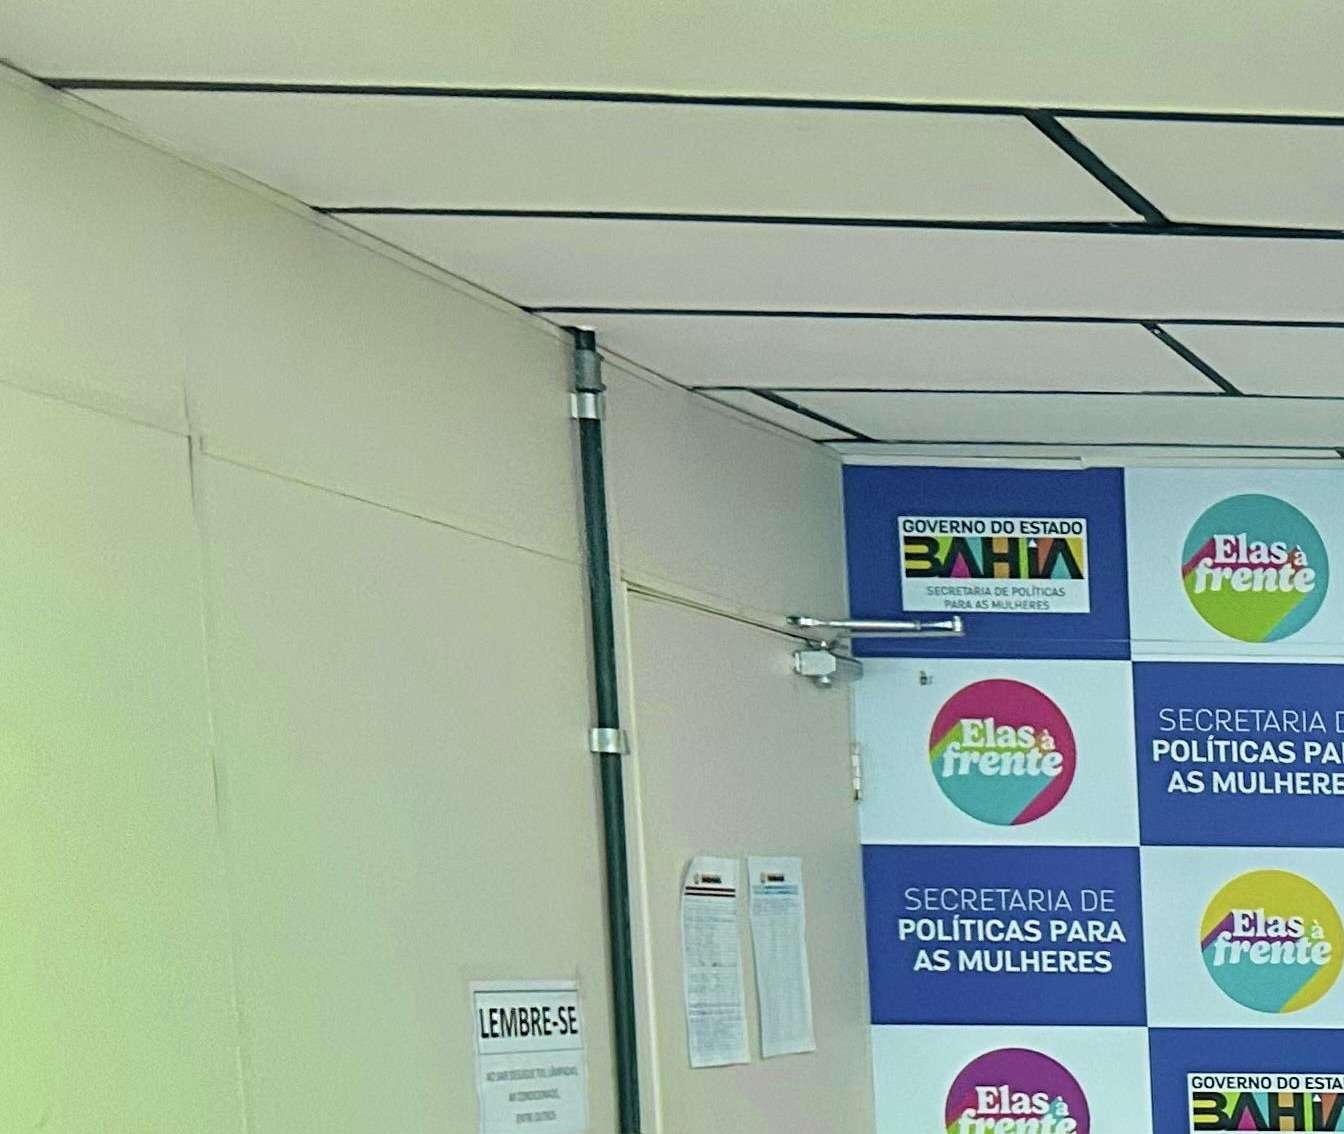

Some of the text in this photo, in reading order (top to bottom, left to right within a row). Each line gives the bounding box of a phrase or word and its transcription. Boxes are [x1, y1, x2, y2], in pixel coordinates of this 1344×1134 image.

[1212, 532, 1289, 564] Elas
[1193, 557, 1316, 595] frente
[960, 717, 1036, 748] Elas
[940, 741, 1063, 779] frente
[903, 888, 1114, 911] SECRETARIA DE
[898, 915, 1126, 942] POLÍTICAS PARA
[913, 950, 1112, 972] AS MULHERES
[479, 1006, 578, 1039] LEMBRE-SE
